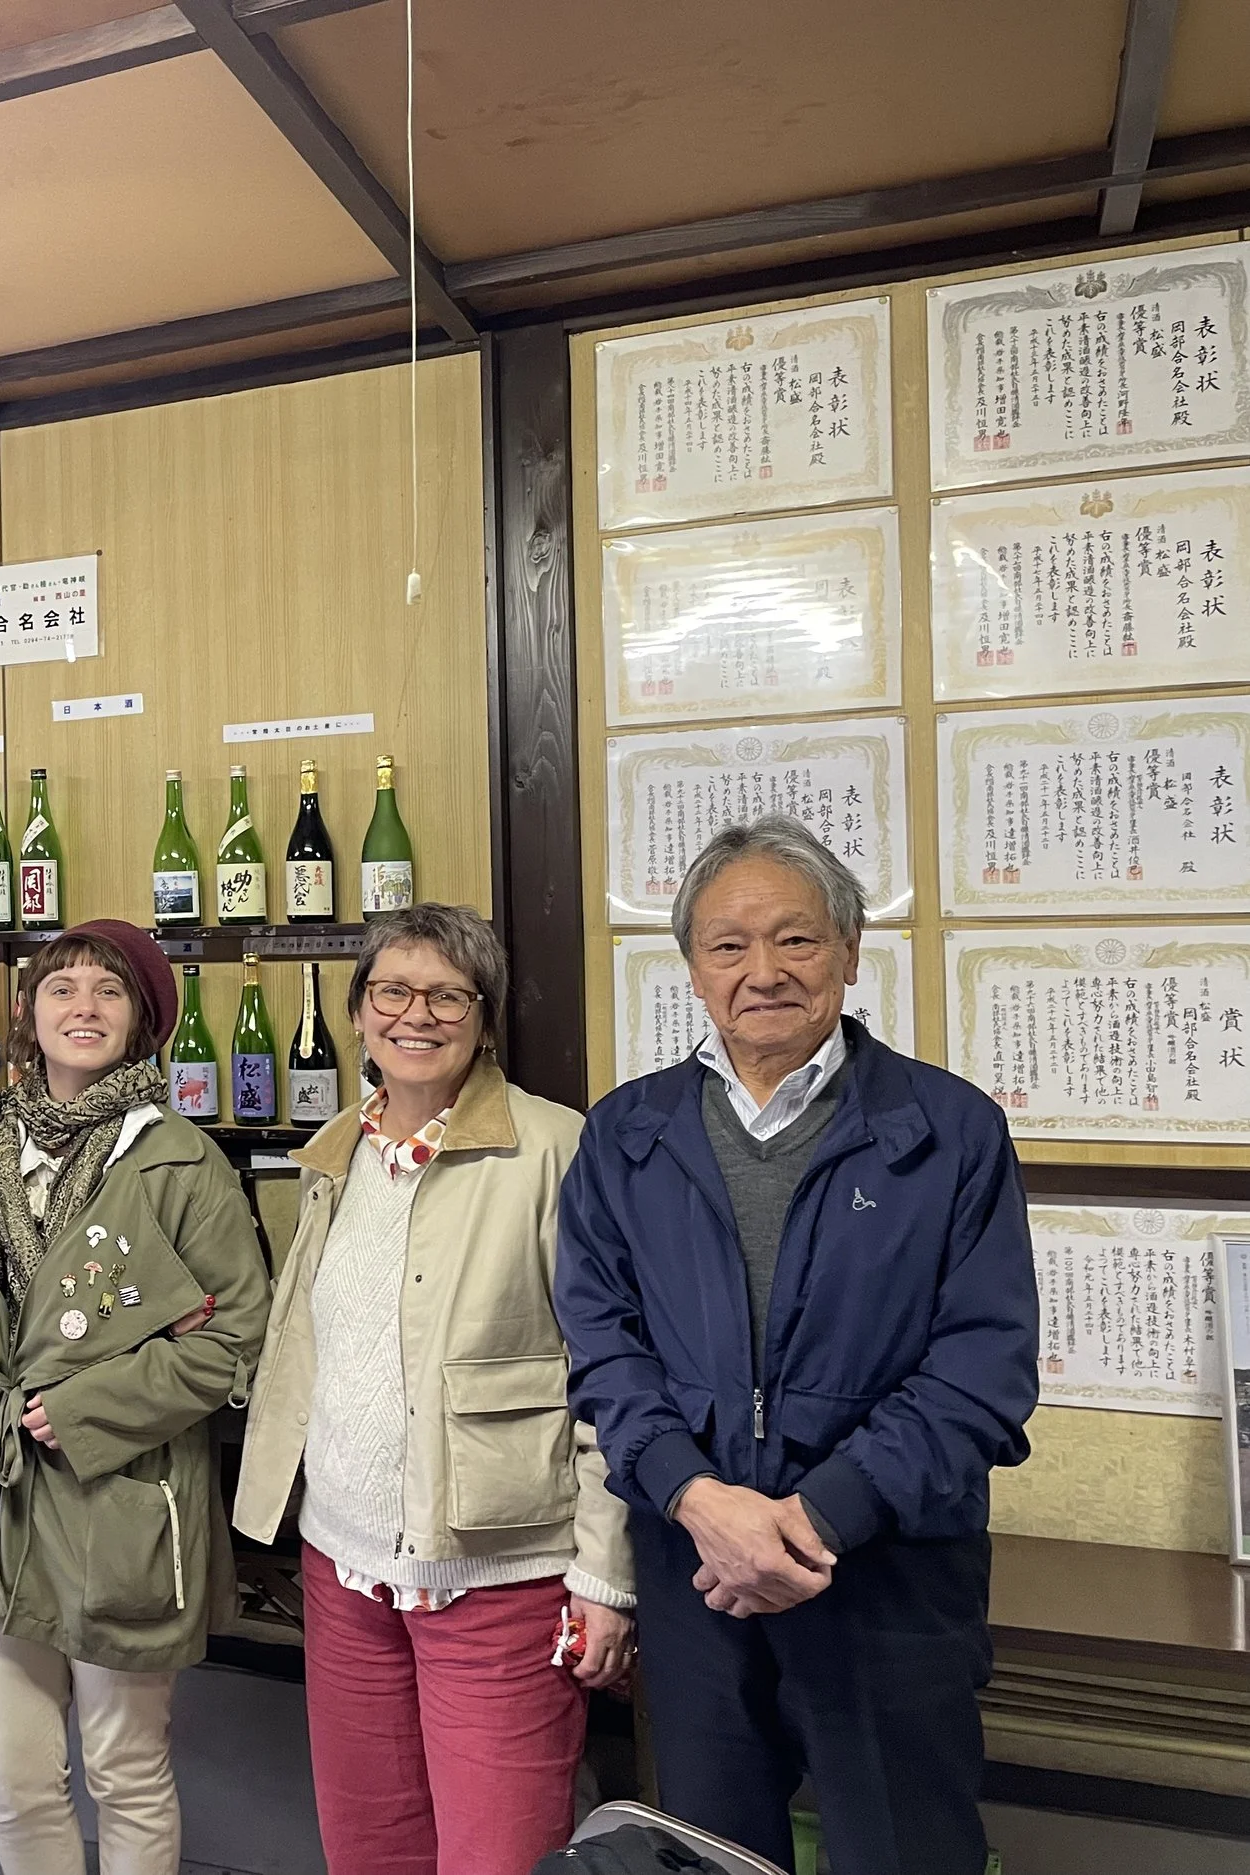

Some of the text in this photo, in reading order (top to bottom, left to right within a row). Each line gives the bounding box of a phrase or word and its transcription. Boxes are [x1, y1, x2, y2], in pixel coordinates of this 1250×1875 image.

[1044, 319, 1057, 404] これを表彰します
[1129, 306, 1148, 355] 優等賞
[1149, 304, 1167, 357] 清酒 松盛
[1195, 317, 1221, 392] 表彰状
[772, 357, 787, 403] 優等賞
[788, 354, 802, 404] 清酒 松盛
[826, 367, 851, 437] 表彰状
[1059, 315, 1075, 440] 努めた成果と認めここに
[1094, 312, 1109, 435] 右の成績をおさめたことは
[1170, 321, 1192, 426] 岡部合名会社殿
[697, 369, 708, 451] これを表彰します
[808, 372, 826, 466] 岡部合名会社殿
[1048, 535, 1061, 623] これを表彰します
[1134, 526, 1154, 577] 優等賞
[1155, 524, 1171, 578] 清酒 松盛
[1199, 540, 1227, 616] 表彰状
[1062, 532, 1078, 659] 努めた成果と認めここに
[1099, 530, 1113, 656] 右の成績をおさめたことは
[1174, 541, 1197, 648] 岡部合名会社殿
[63, 698, 133, 715] 日本酒
[783, 771, 800, 817] 優等賞
[800, 769, 815, 821] 清酒 松盛
[1055, 754, 1067, 843] これを表彰します
[1143, 749, 1162, 800] 優等賞
[1163, 749, 1177, 810] 清酒 松盛
[1209, 766, 1236, 845] 表彰状
[841, 786, 866, 858] 表彰状
[1071, 752, 1086, 880] 努めた成果と認めここに
[1107, 751, 1121, 879] 右の成績をおさめたことは
[1179, 772, 1197, 874] 岡部合名会社 殿
[220, 870, 252, 913] 助さん 格さん
[294, 866, 310, 906] 悪代官
[1161, 977, 1179, 1029] 優等賞
[1199, 978, 1211, 1022] 清酒 松盛
[1125, 977, 1140, 1106] 右の成績をおさめたことは
[1182, 1007, 1202, 1101] 岡部合名会社殿
[1219, 1010, 1244, 1067] 賞状
[239, 1057, 261, 1111] 松盛
[298, 1085, 319, 1104] 松盛
[1200, 1252, 1216, 1304] 優等賞
[1161, 1250, 1177, 1381] 右の成績をおさめたことは
